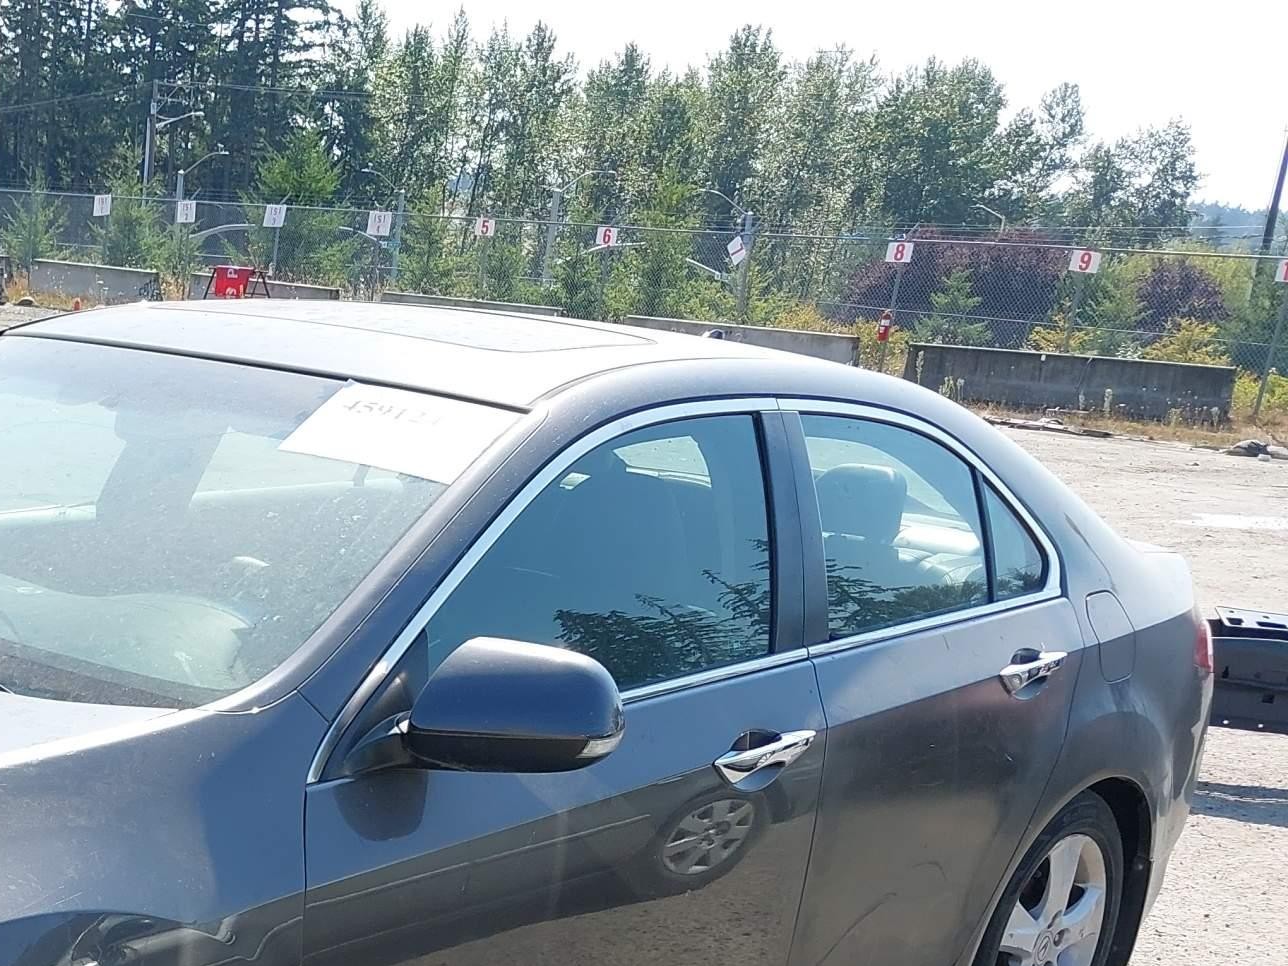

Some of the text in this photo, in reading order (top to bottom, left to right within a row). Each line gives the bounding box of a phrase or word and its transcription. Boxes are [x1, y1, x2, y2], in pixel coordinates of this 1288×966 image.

[480, 219, 490, 235] 5
[602, 228, 612, 244] 6
[893, 243, 905, 262] 8
[1078, 252, 1092, 272] 9
